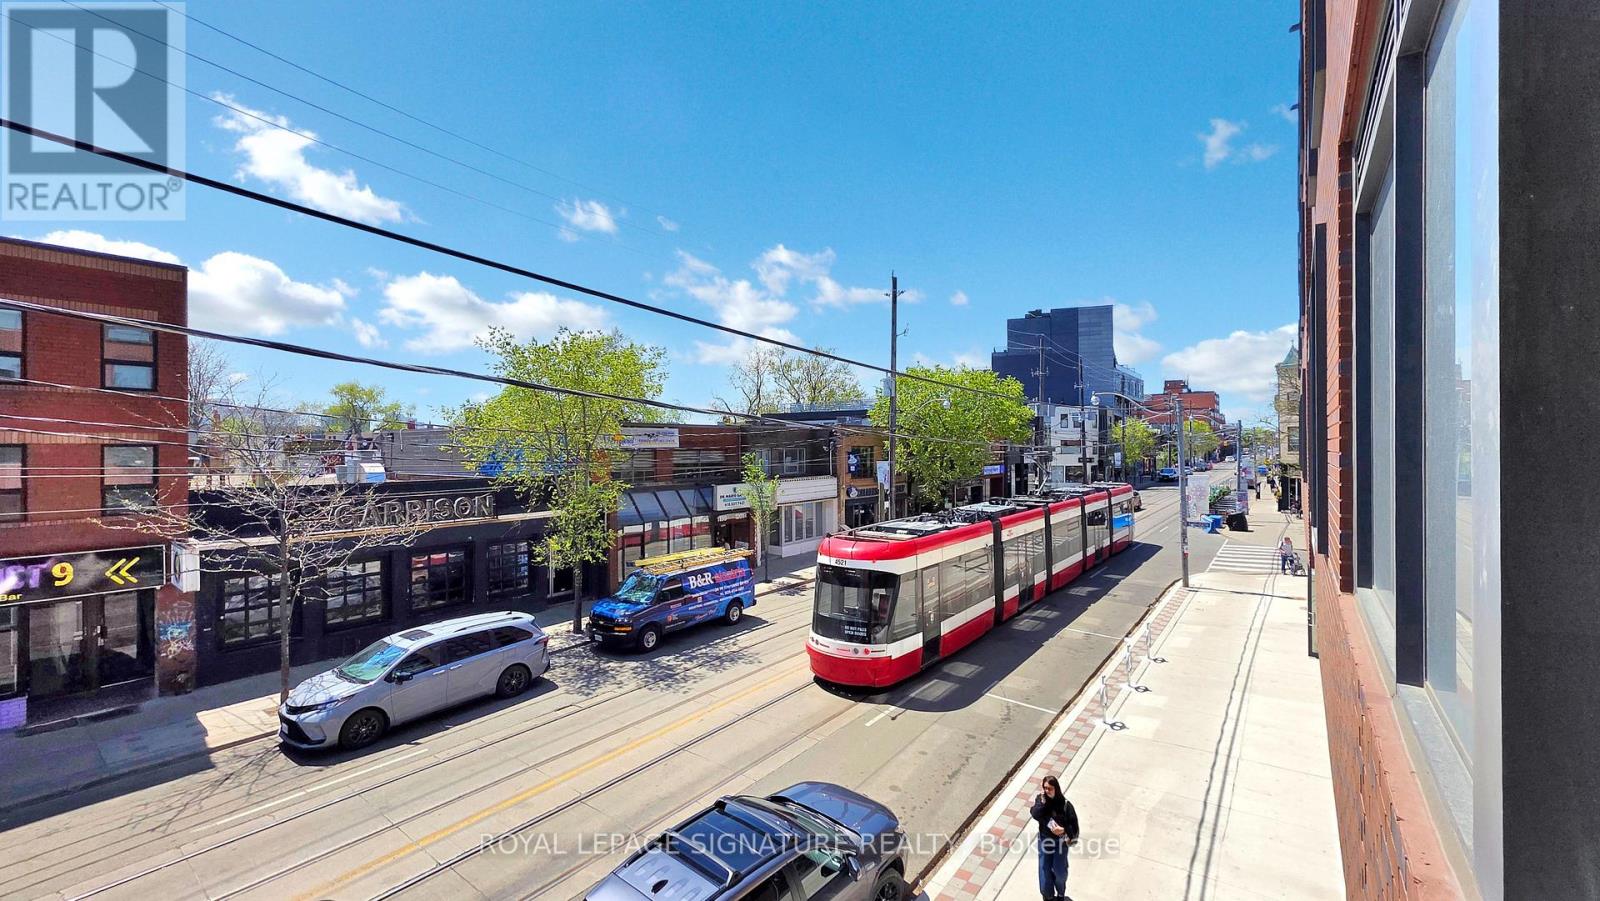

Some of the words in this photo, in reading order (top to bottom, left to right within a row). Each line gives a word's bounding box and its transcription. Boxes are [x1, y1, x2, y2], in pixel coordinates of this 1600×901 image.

[335, 495, 495, 529] GARRISON
[51, 562, 74, 586] 9
[688, 572, 714, 589] B&R
